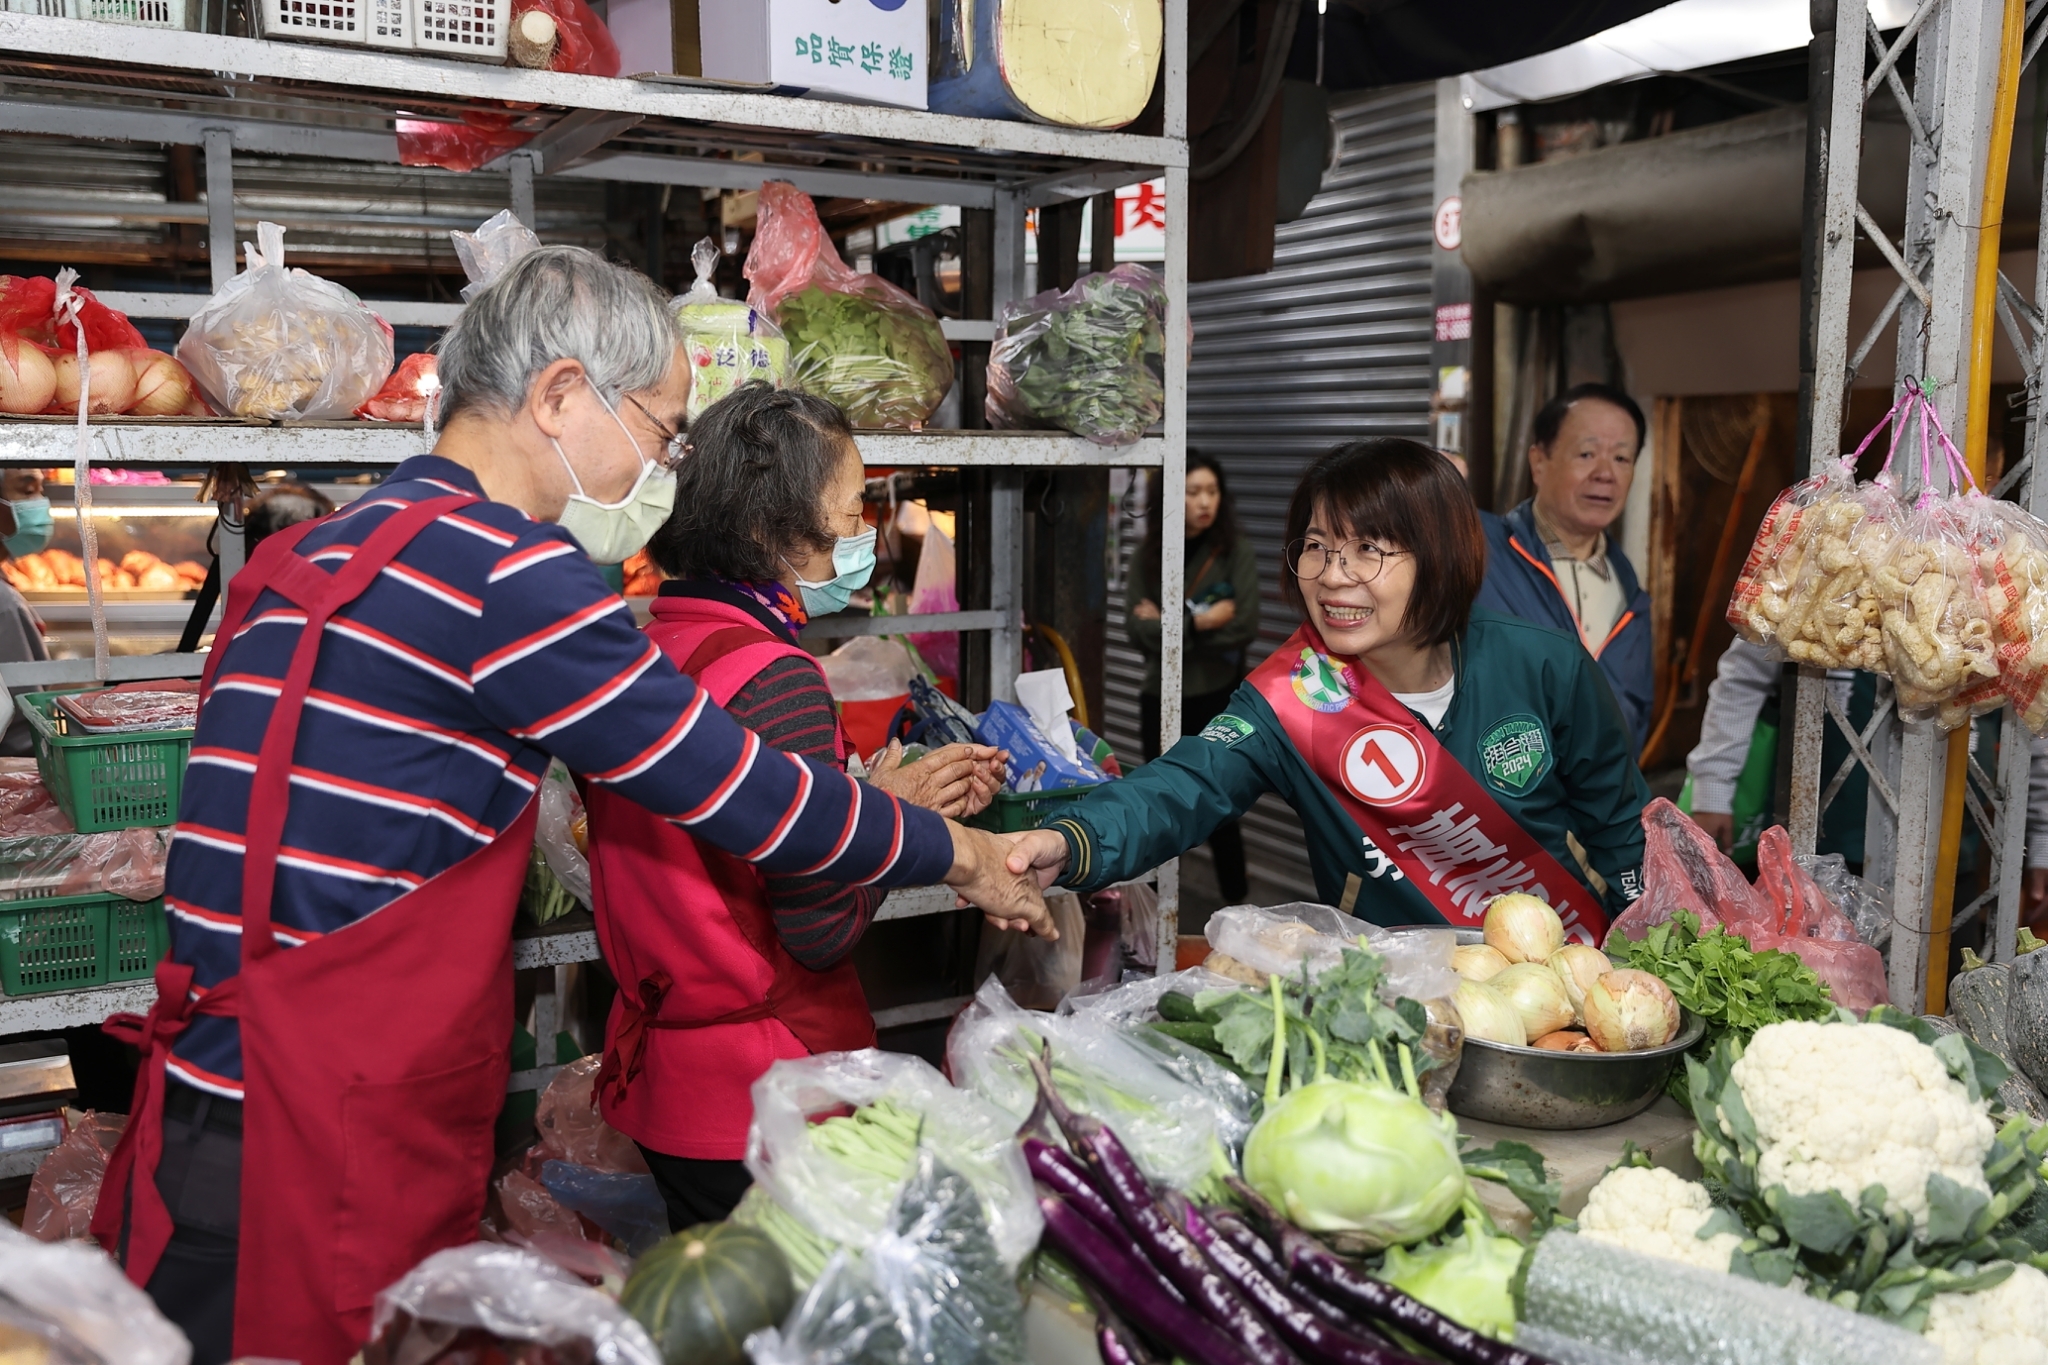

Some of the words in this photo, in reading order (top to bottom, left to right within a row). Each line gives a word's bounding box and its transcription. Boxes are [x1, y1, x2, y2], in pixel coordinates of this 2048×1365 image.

[795, 32, 913, 81] 品質保證
[1361, 738, 1405, 788] 1
[1501, 753, 1533, 777] 2024
[1620, 868, 1641, 901] TEAM
